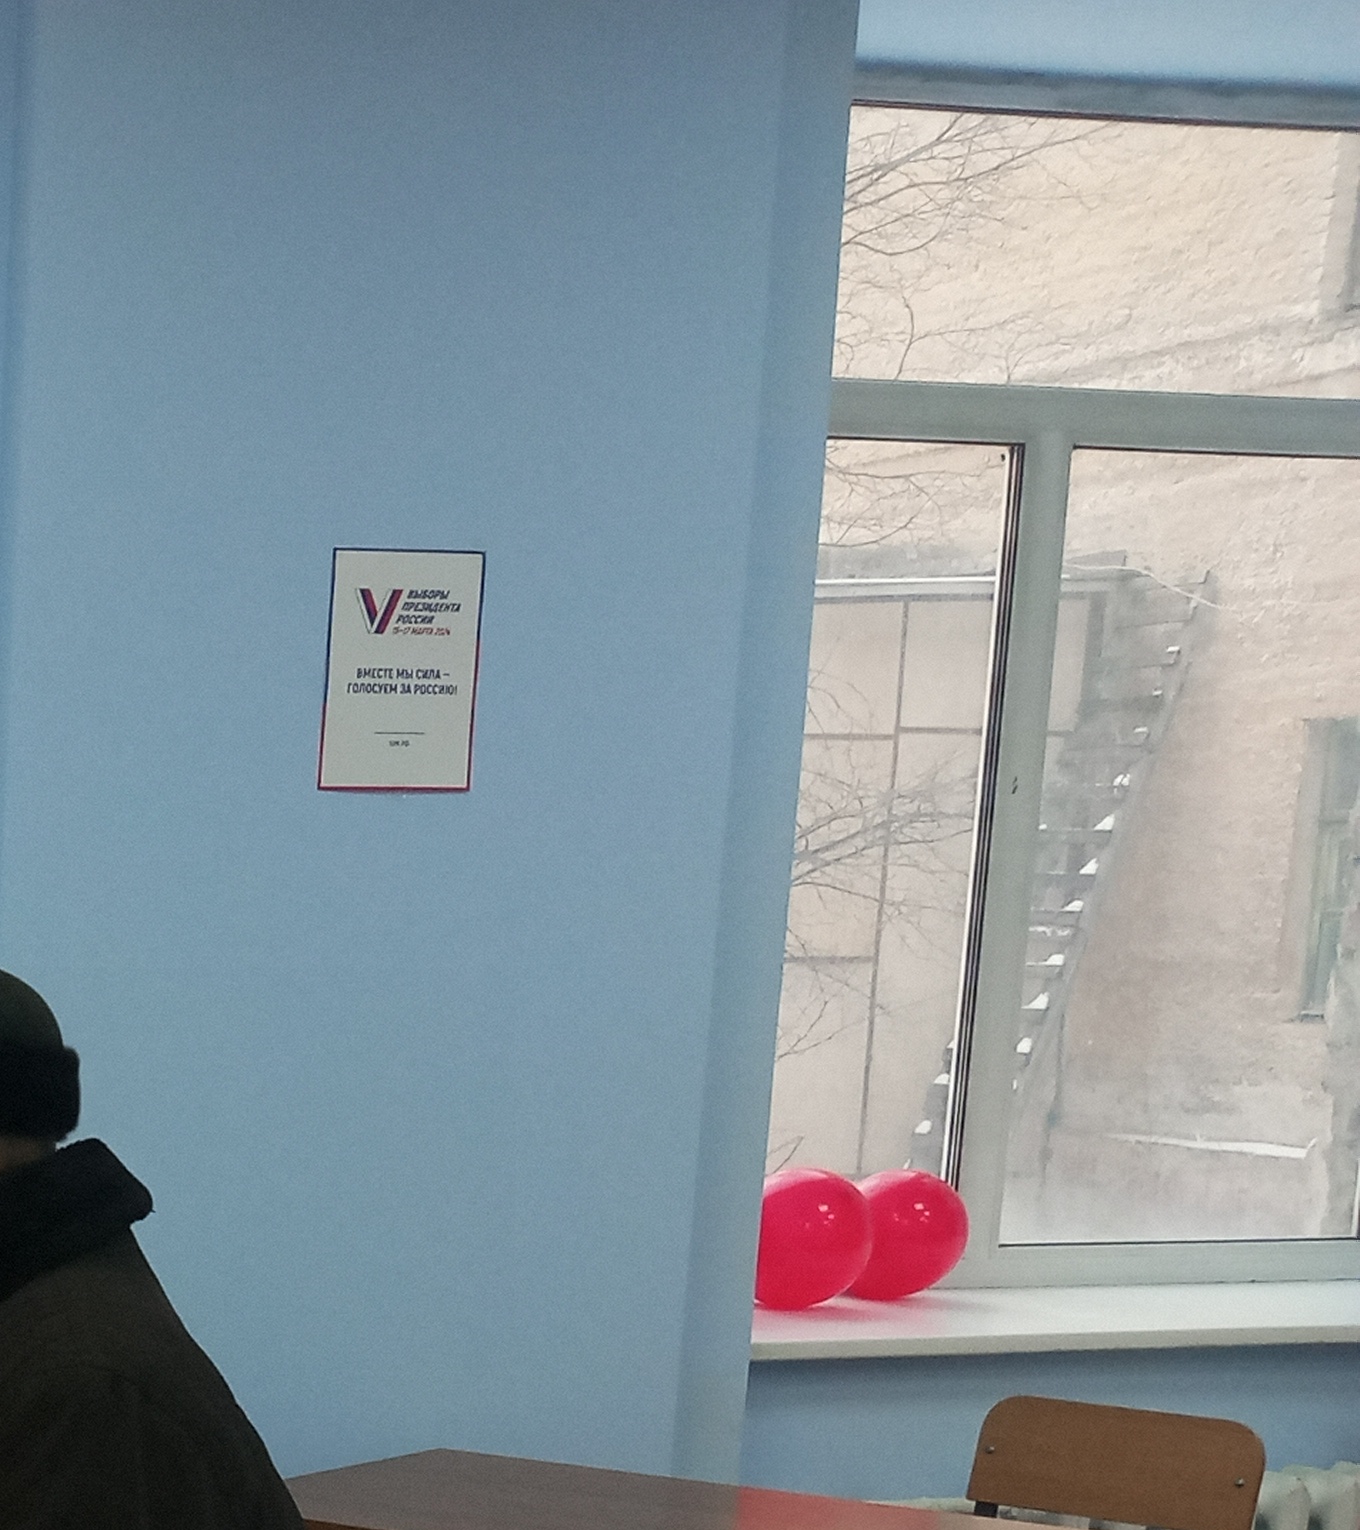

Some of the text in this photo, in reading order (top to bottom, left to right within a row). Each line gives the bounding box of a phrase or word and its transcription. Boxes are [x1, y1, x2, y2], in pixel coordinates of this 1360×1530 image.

[407, 589, 451, 600] ВЫБОРЫ
[401, 602, 461, 613] ПРЕЗИДЕНТА
[395, 615, 435, 625] РОССИИ
[356, 667, 441, 680] ВМЕСТЕ МЫ СИЛА
[346, 682, 458, 696] ГОЛОСУЕМ ЗА РОССИЮ!
